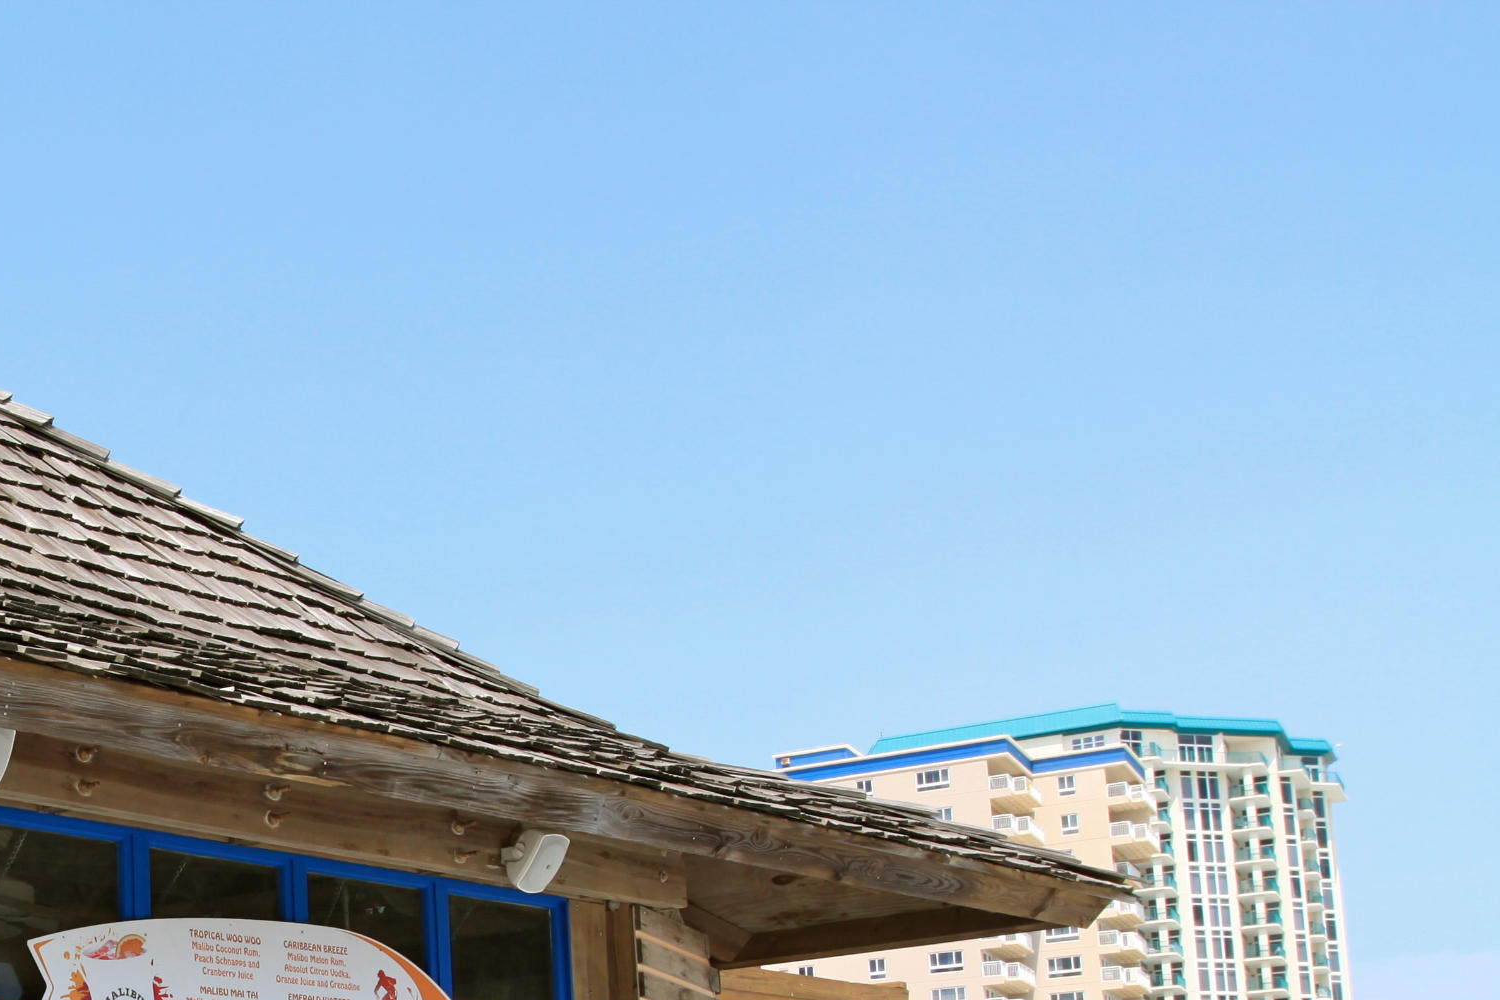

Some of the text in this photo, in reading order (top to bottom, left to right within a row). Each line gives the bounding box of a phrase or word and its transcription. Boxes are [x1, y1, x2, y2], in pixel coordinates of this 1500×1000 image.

[189, 928, 261, 945] TROPICAL WOO WOO
[191, 941, 214, 951] Malibu
[216, 944, 241, 954] Coconut
[283, 940, 348, 955] CARIBBEAN BREEZE
[194, 953, 260, 969] Peach Schnapps and
[287, 952, 308, 962] Malibu
[310, 955, 329, 964] Melon
[202, 966, 254, 980] Cranberry Juice
[284, 964, 308, 974] Absolut
[309, 966, 329, 976] Citron
[276, 975, 361, 991] Orange Juice and Grenadine
[200, 986, 259, 1000] MALIBU MAI TAI
